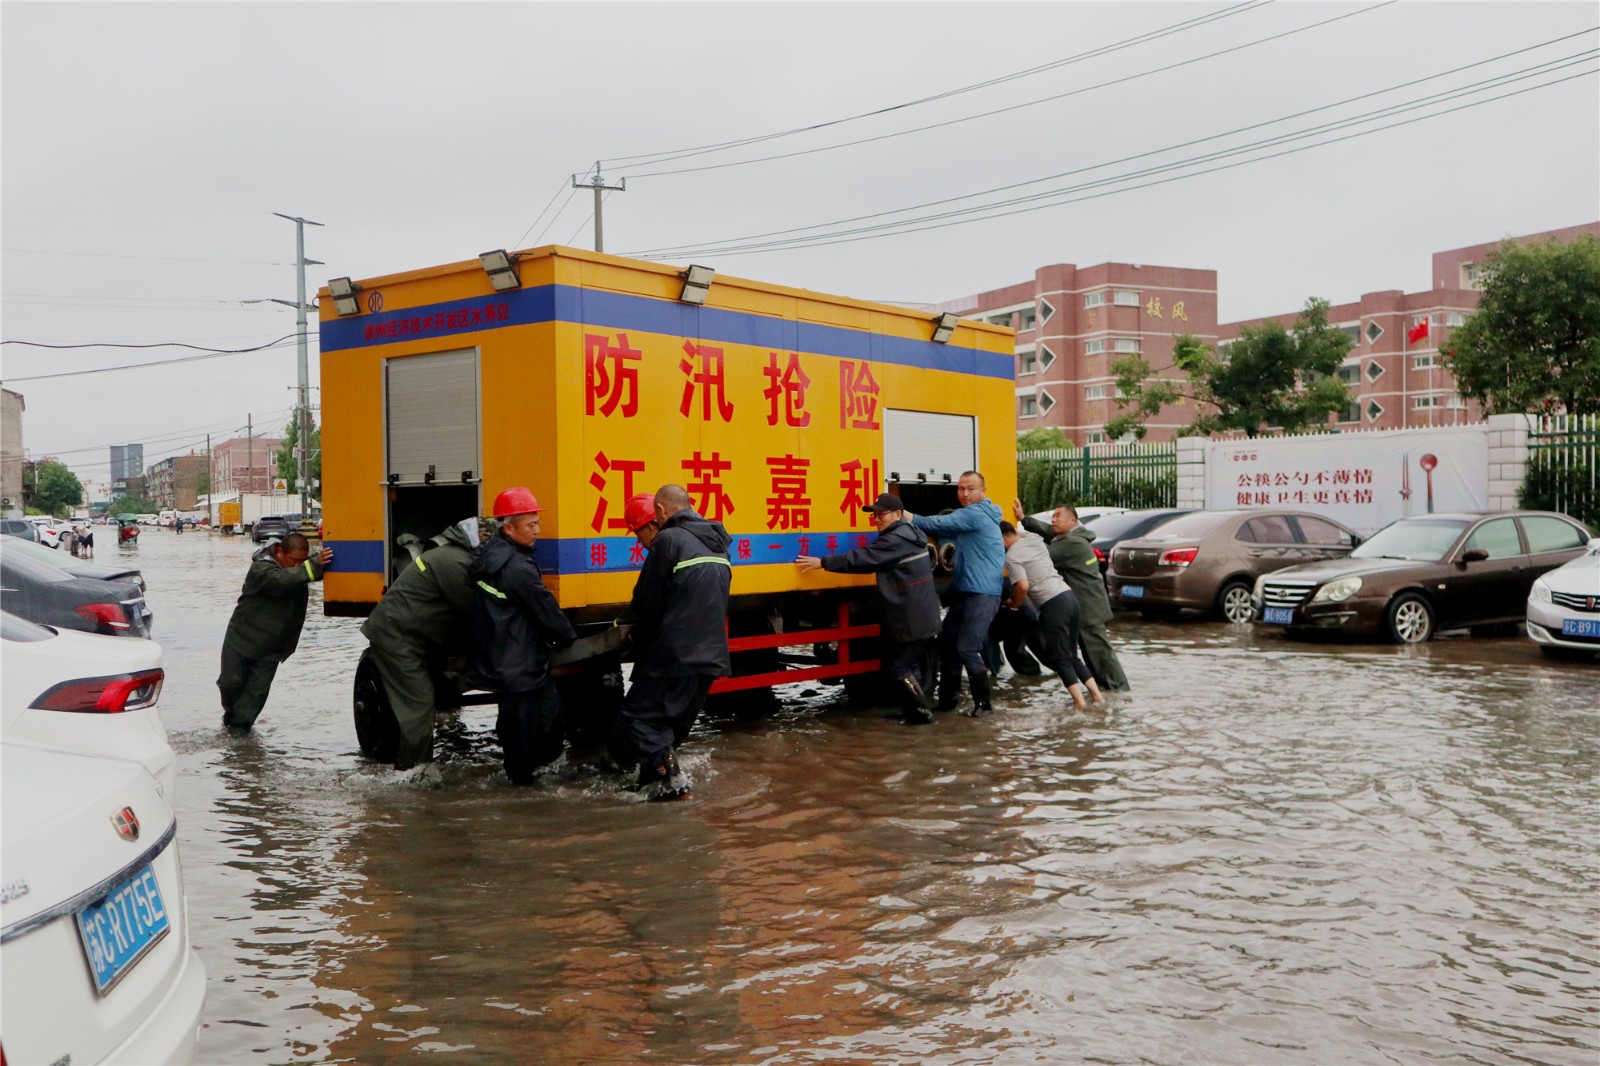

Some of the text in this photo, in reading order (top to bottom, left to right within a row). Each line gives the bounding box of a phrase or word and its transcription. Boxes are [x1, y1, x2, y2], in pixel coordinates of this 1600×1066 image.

[1146, 297, 1188, 321] 校风
[585, 334, 880, 431] 防汛抢险
[1237, 469, 1373, 486] 公筷公勺不薄情
[589, 450, 879, 534] 江苏嘉利
[1237, 489, 1373, 505] 健康卫生更真情
